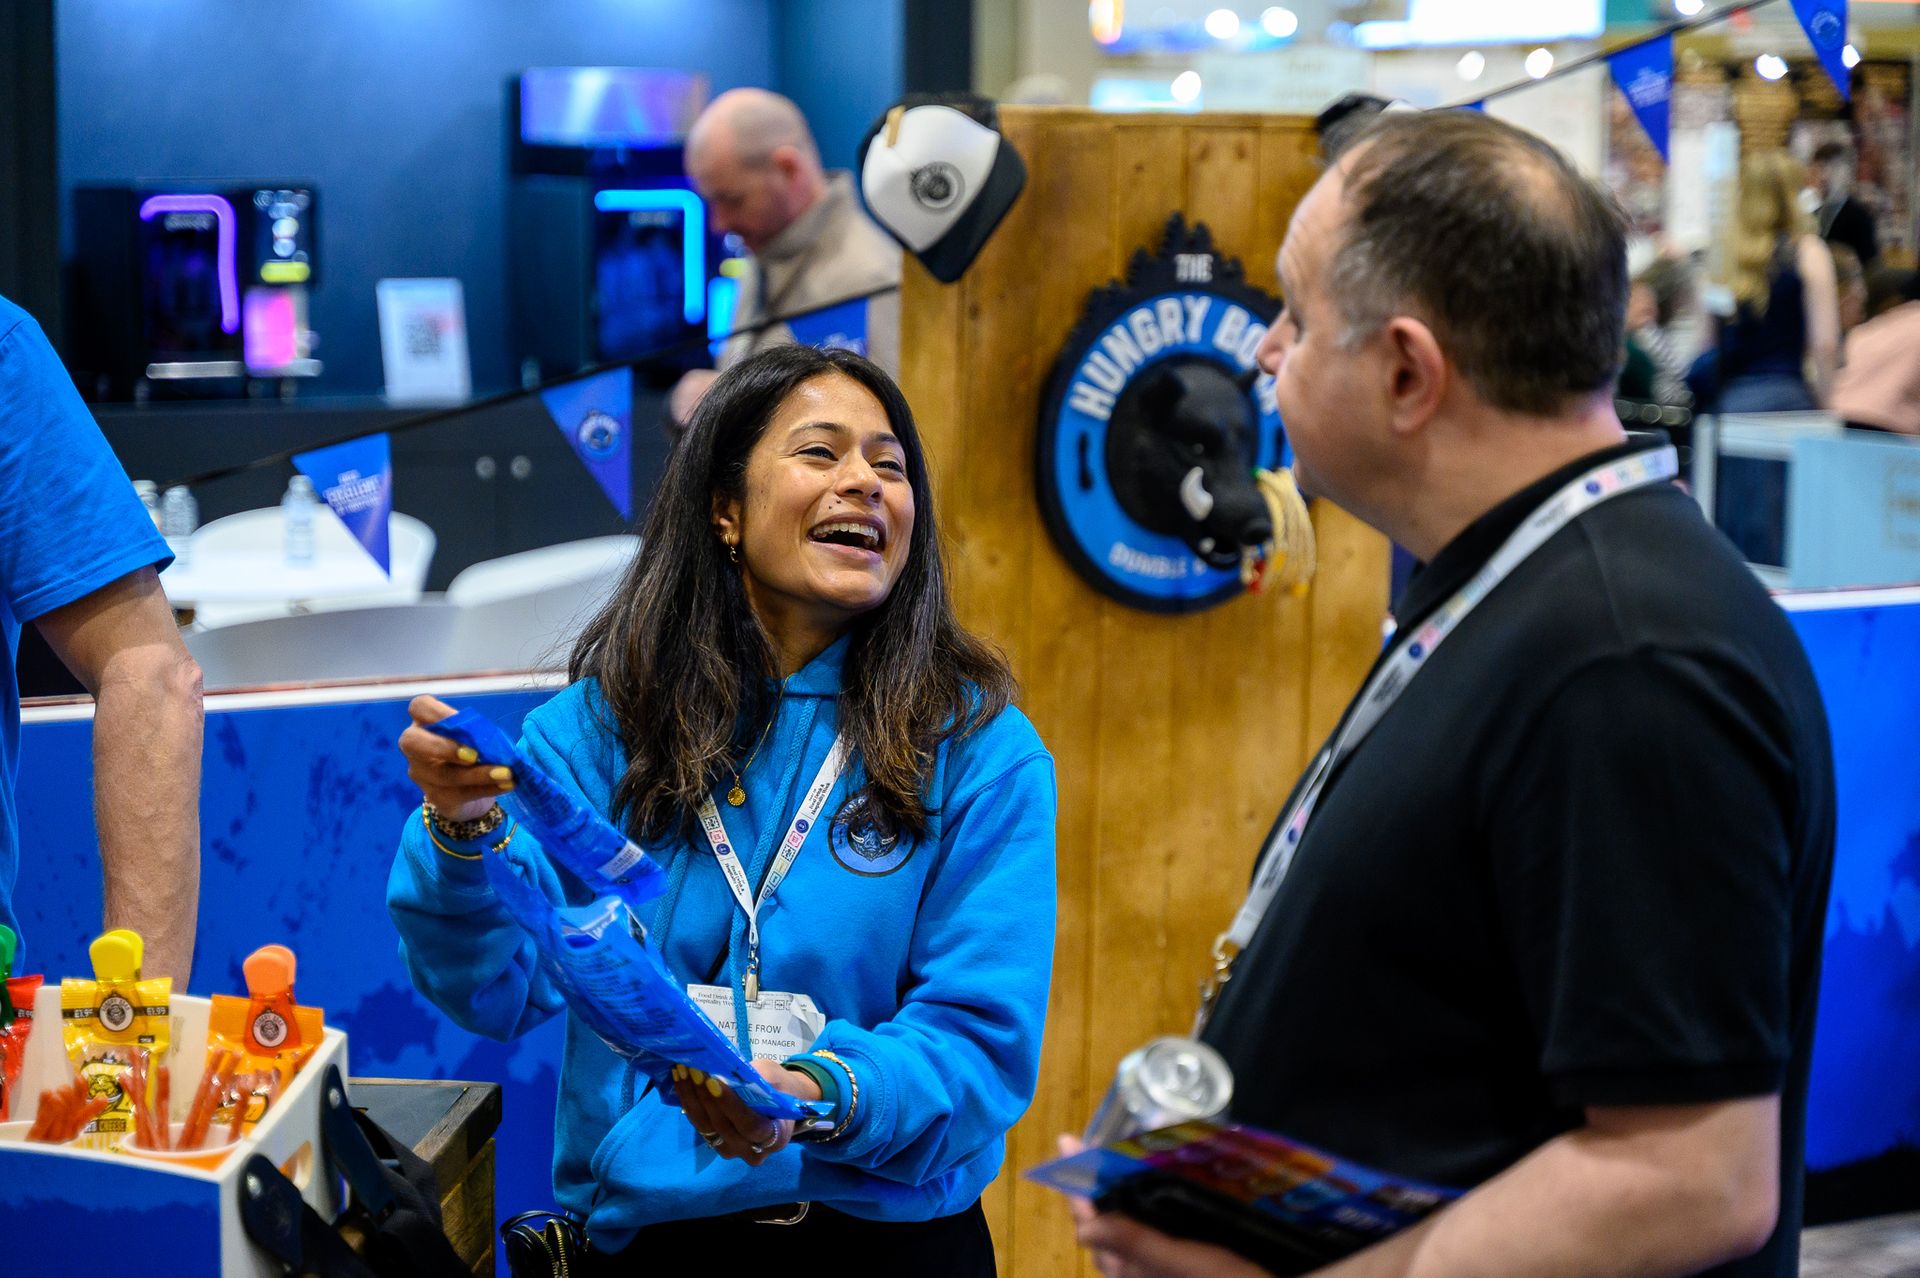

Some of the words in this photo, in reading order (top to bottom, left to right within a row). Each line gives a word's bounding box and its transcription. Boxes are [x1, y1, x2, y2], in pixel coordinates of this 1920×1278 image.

[1174, 253, 1213, 282] THE
[1068, 294, 1212, 421] HUNGRY
[755, 1024, 782, 1034] FROW
[762, 1039, 796, 1048] MANAGER
[753, 1052, 777, 1061] FOODS
